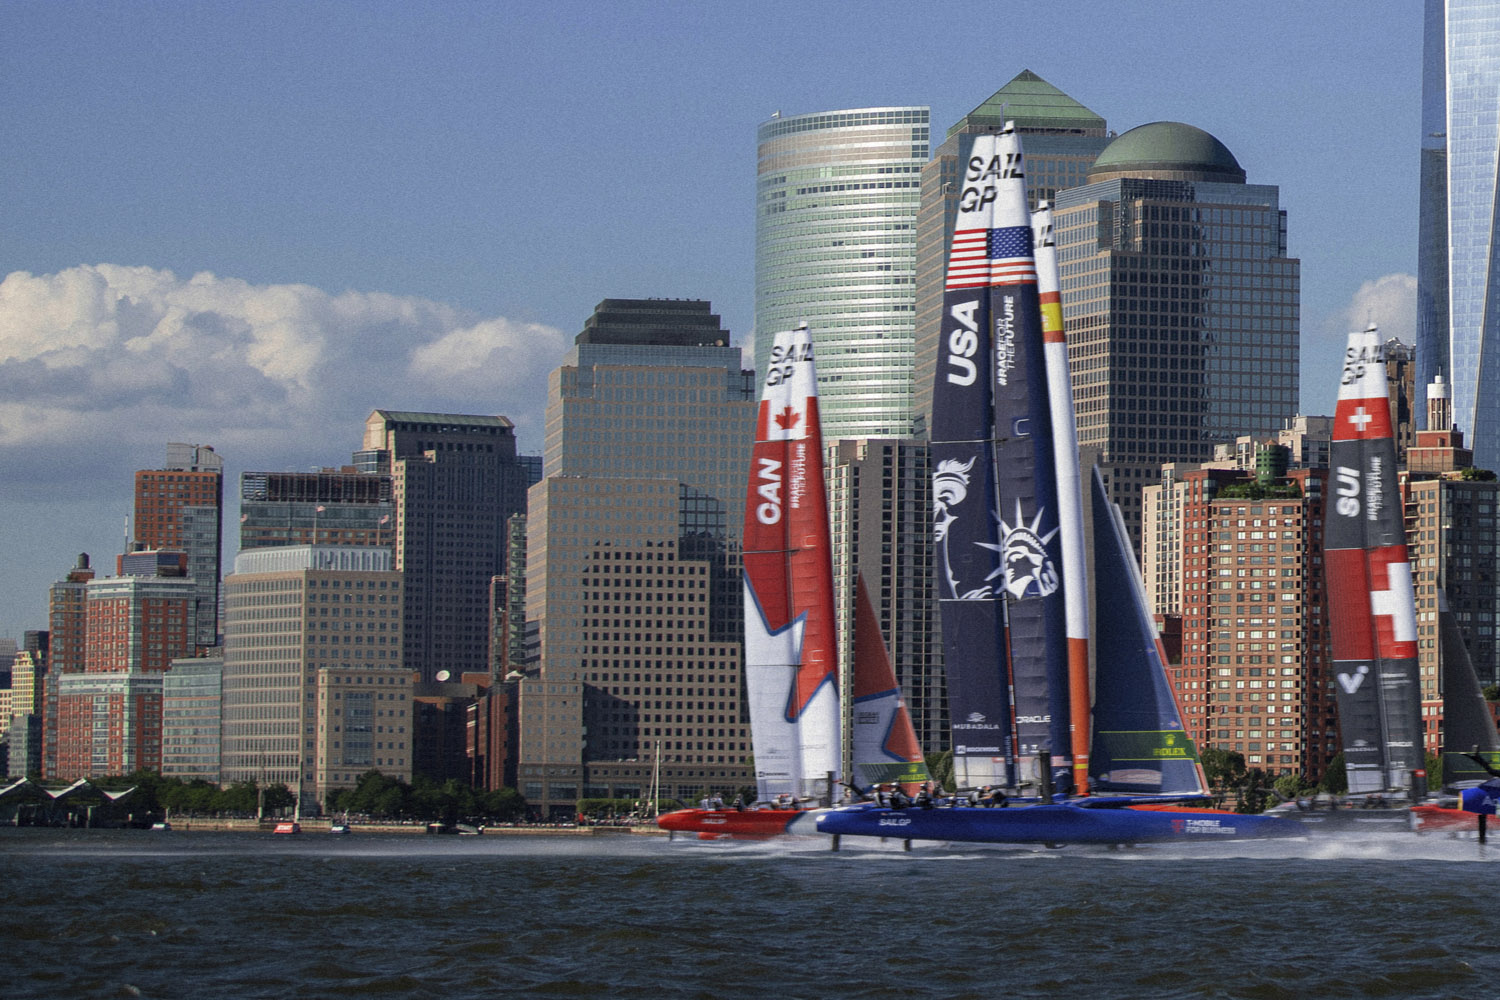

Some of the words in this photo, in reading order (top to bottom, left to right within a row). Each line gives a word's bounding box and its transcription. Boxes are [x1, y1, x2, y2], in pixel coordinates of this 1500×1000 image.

[966, 152, 1025, 182] SAIL
[959, 185, 997, 213] GP
[946, 299, 980, 388] USA
[997, 317, 1008, 387] #RACEFOR
[1004, 295, 1015, 370] THEFUTURE
[770, 343, 814, 365] SAIL
[766, 365, 794, 387] GP
[756, 457, 783, 525] CAN
[1336, 466, 1361, 518] SUI
[1016, 715, 1051, 724] ORACLE
